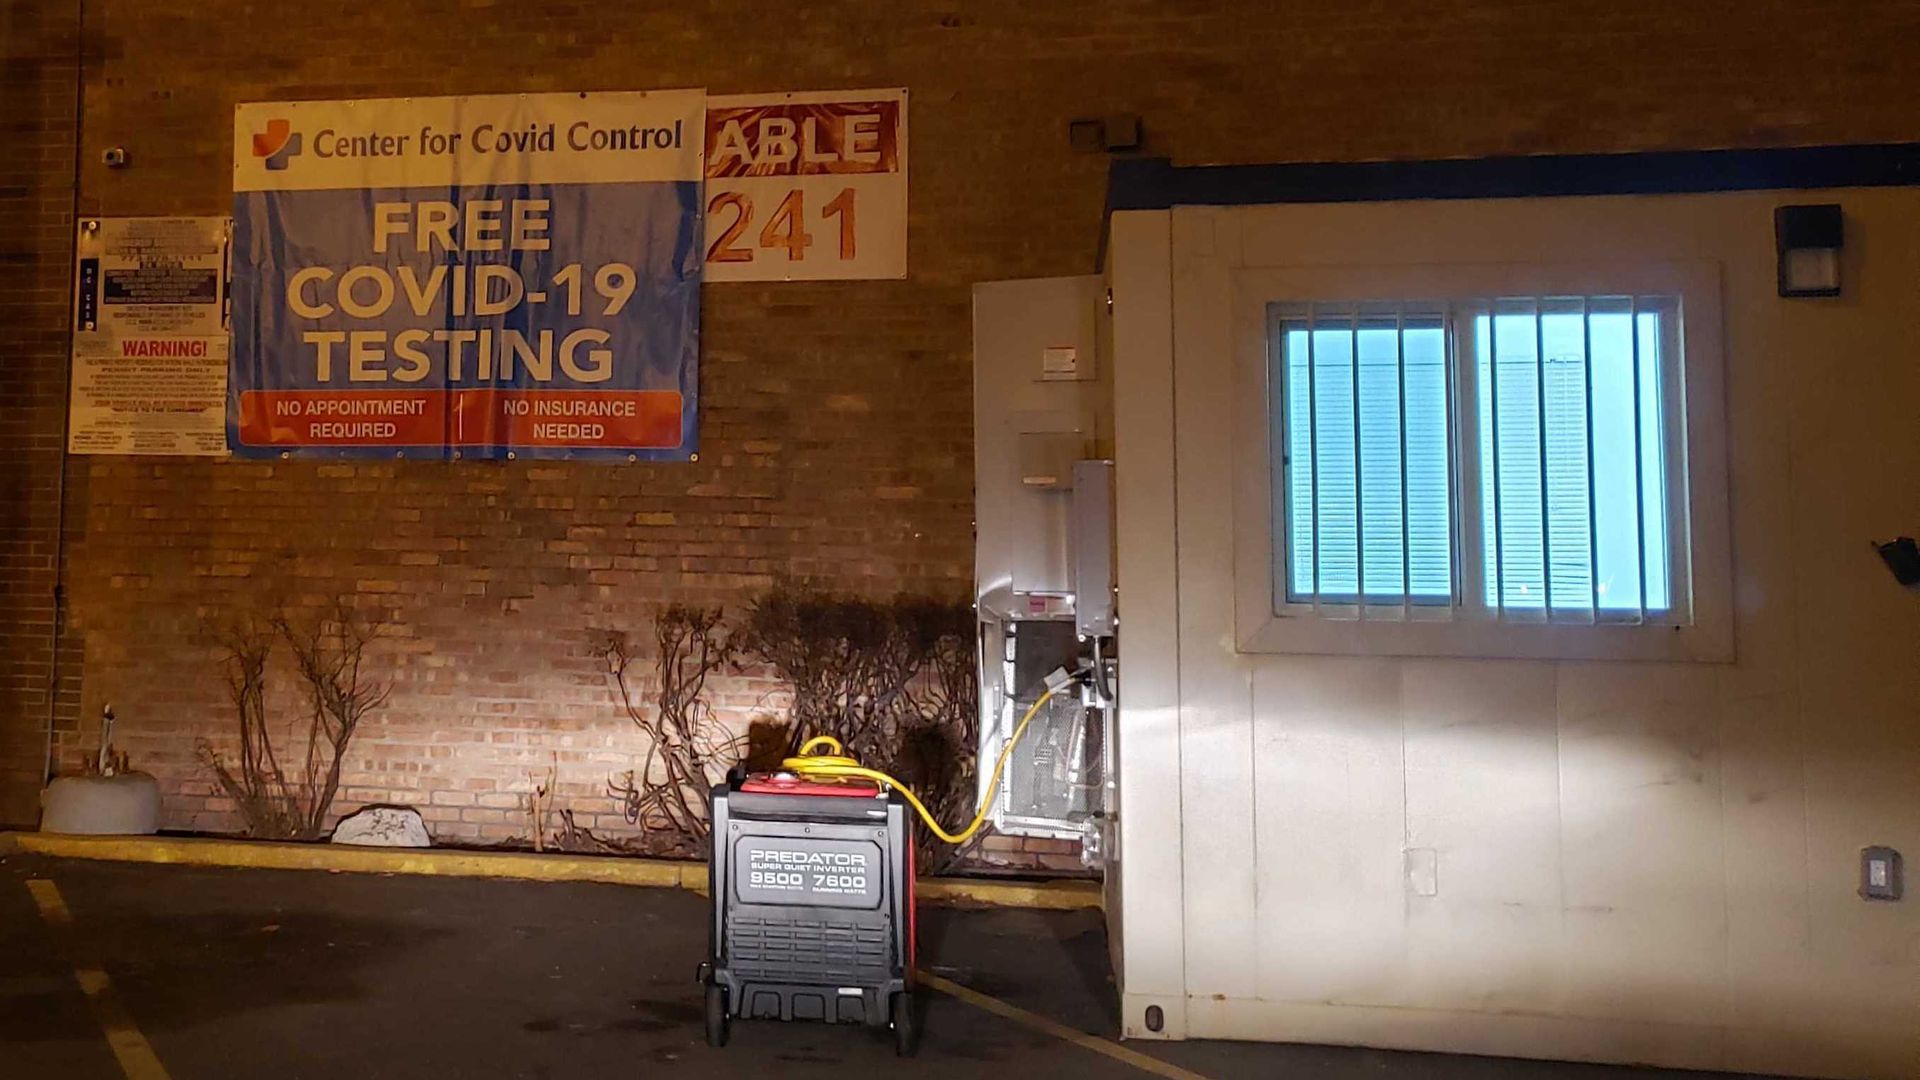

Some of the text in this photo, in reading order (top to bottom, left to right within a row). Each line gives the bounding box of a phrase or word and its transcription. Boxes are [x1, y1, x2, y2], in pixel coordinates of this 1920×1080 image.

[313, 120, 682, 158] Center for Covid Control
[373, 199, 551, 253] FREE
[706, 188, 856, 262] 241
[287, 262, 637, 319] COVID-19
[122, 340, 208, 357] WARNING!
[303, 328, 613, 383] TESTING
[276, 400, 426, 416] NO APPOINTMENT
[504, 401, 636, 417] NO INSURANCE
[310, 422, 396, 439] REQUIRED
[533, 424, 605, 439] NEEDED
[750, 850, 866, 866] PREDATOR
[751, 862, 865, 874] SUPER QUIET INVERTER
[750, 871, 803, 885] 9500
[813, 874, 866, 888] 7600
